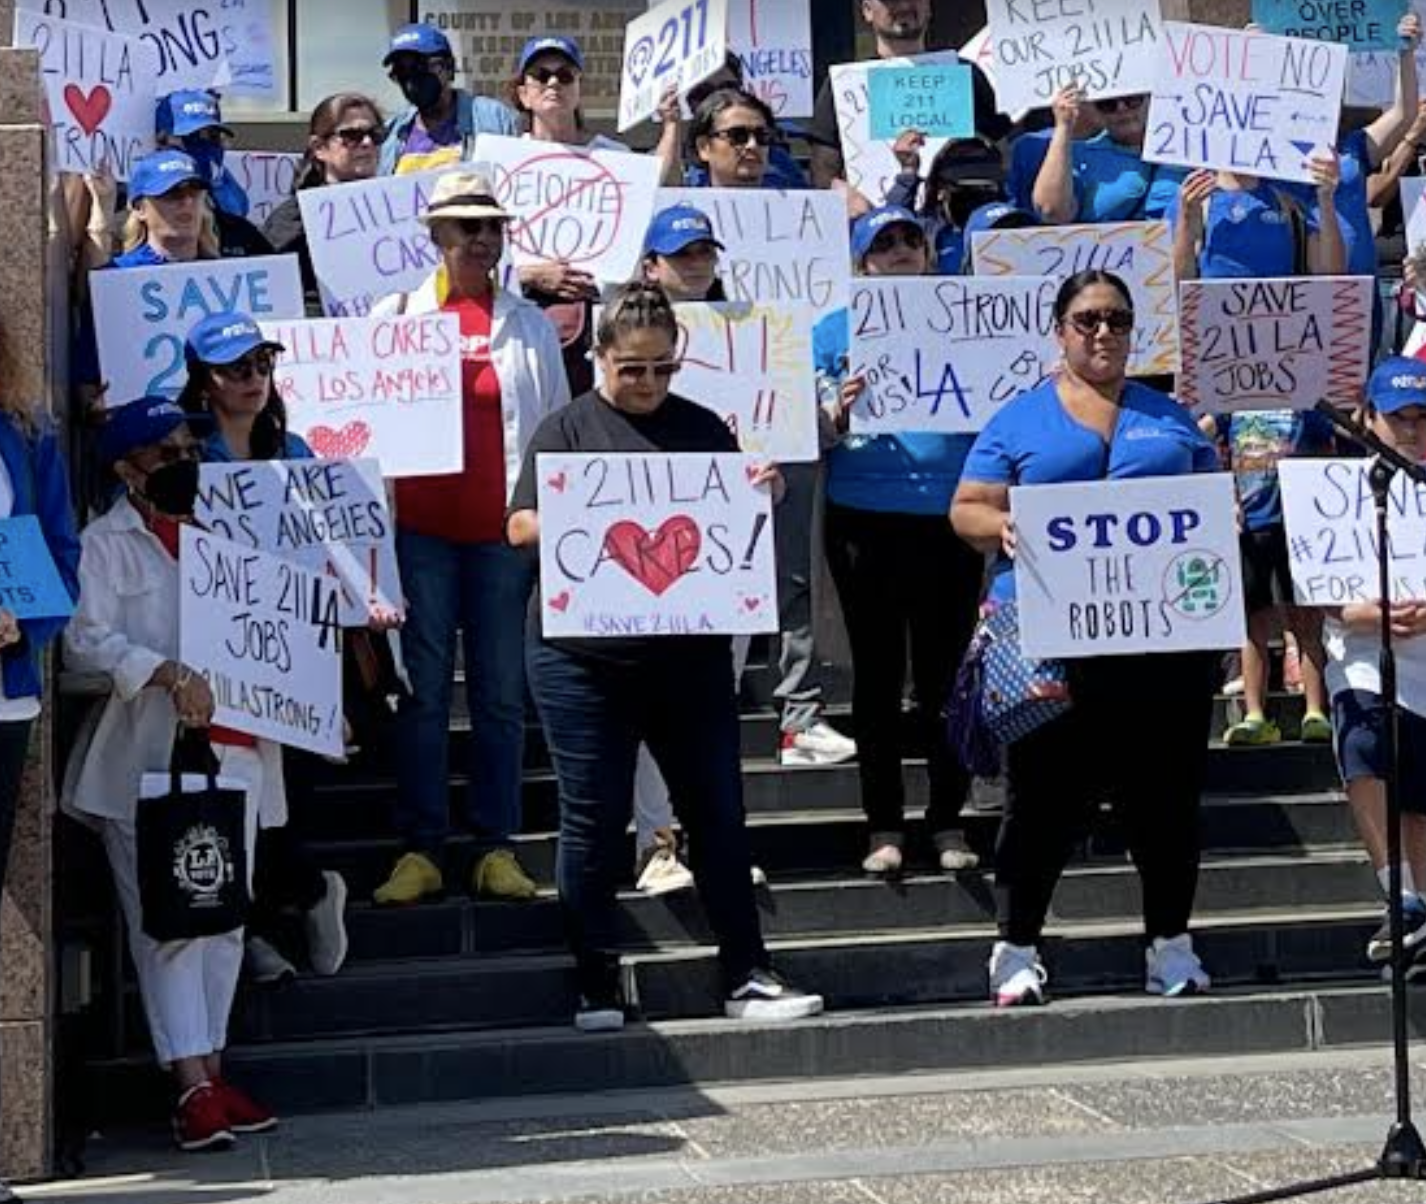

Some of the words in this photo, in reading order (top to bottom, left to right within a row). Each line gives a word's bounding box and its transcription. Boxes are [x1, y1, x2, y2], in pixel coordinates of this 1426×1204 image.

[1299, 1, 1366, 23] OVER
[653, 0, 709, 79] 211
[999, 31, 1054, 66] OUR
[1166, 29, 1264, 81] VOTE
[1280, 42, 1332, 90] NO
[739, 49, 812, 79] NGELES
[894, 74, 946, 90] KEEP
[890, 113, 953, 128] LOCAL
[903, 93, 936, 109] 211
[1181, 83, 1280, 130] SAVE
[141, 269, 275, 323] SAVE
[851, 286, 905, 337] 211
[1221, 280, 1313, 317] SAVE
[372, 319, 453, 360] CARES
[914, 348, 972, 418] LA
[1212, 355, 1298, 397] JOBS
[197, 467, 265, 512] WE
[283, 462, 348, 505] ARE
[1046, 508, 1202, 554] STOP
[191, 537, 262, 607] SAVE
[1086, 553, 1137, 596] THE
[1305, 573, 1370, 603] FOR
[1069, 599, 1174, 641] ROBOTS
[225, 611, 292, 674] JOBS
